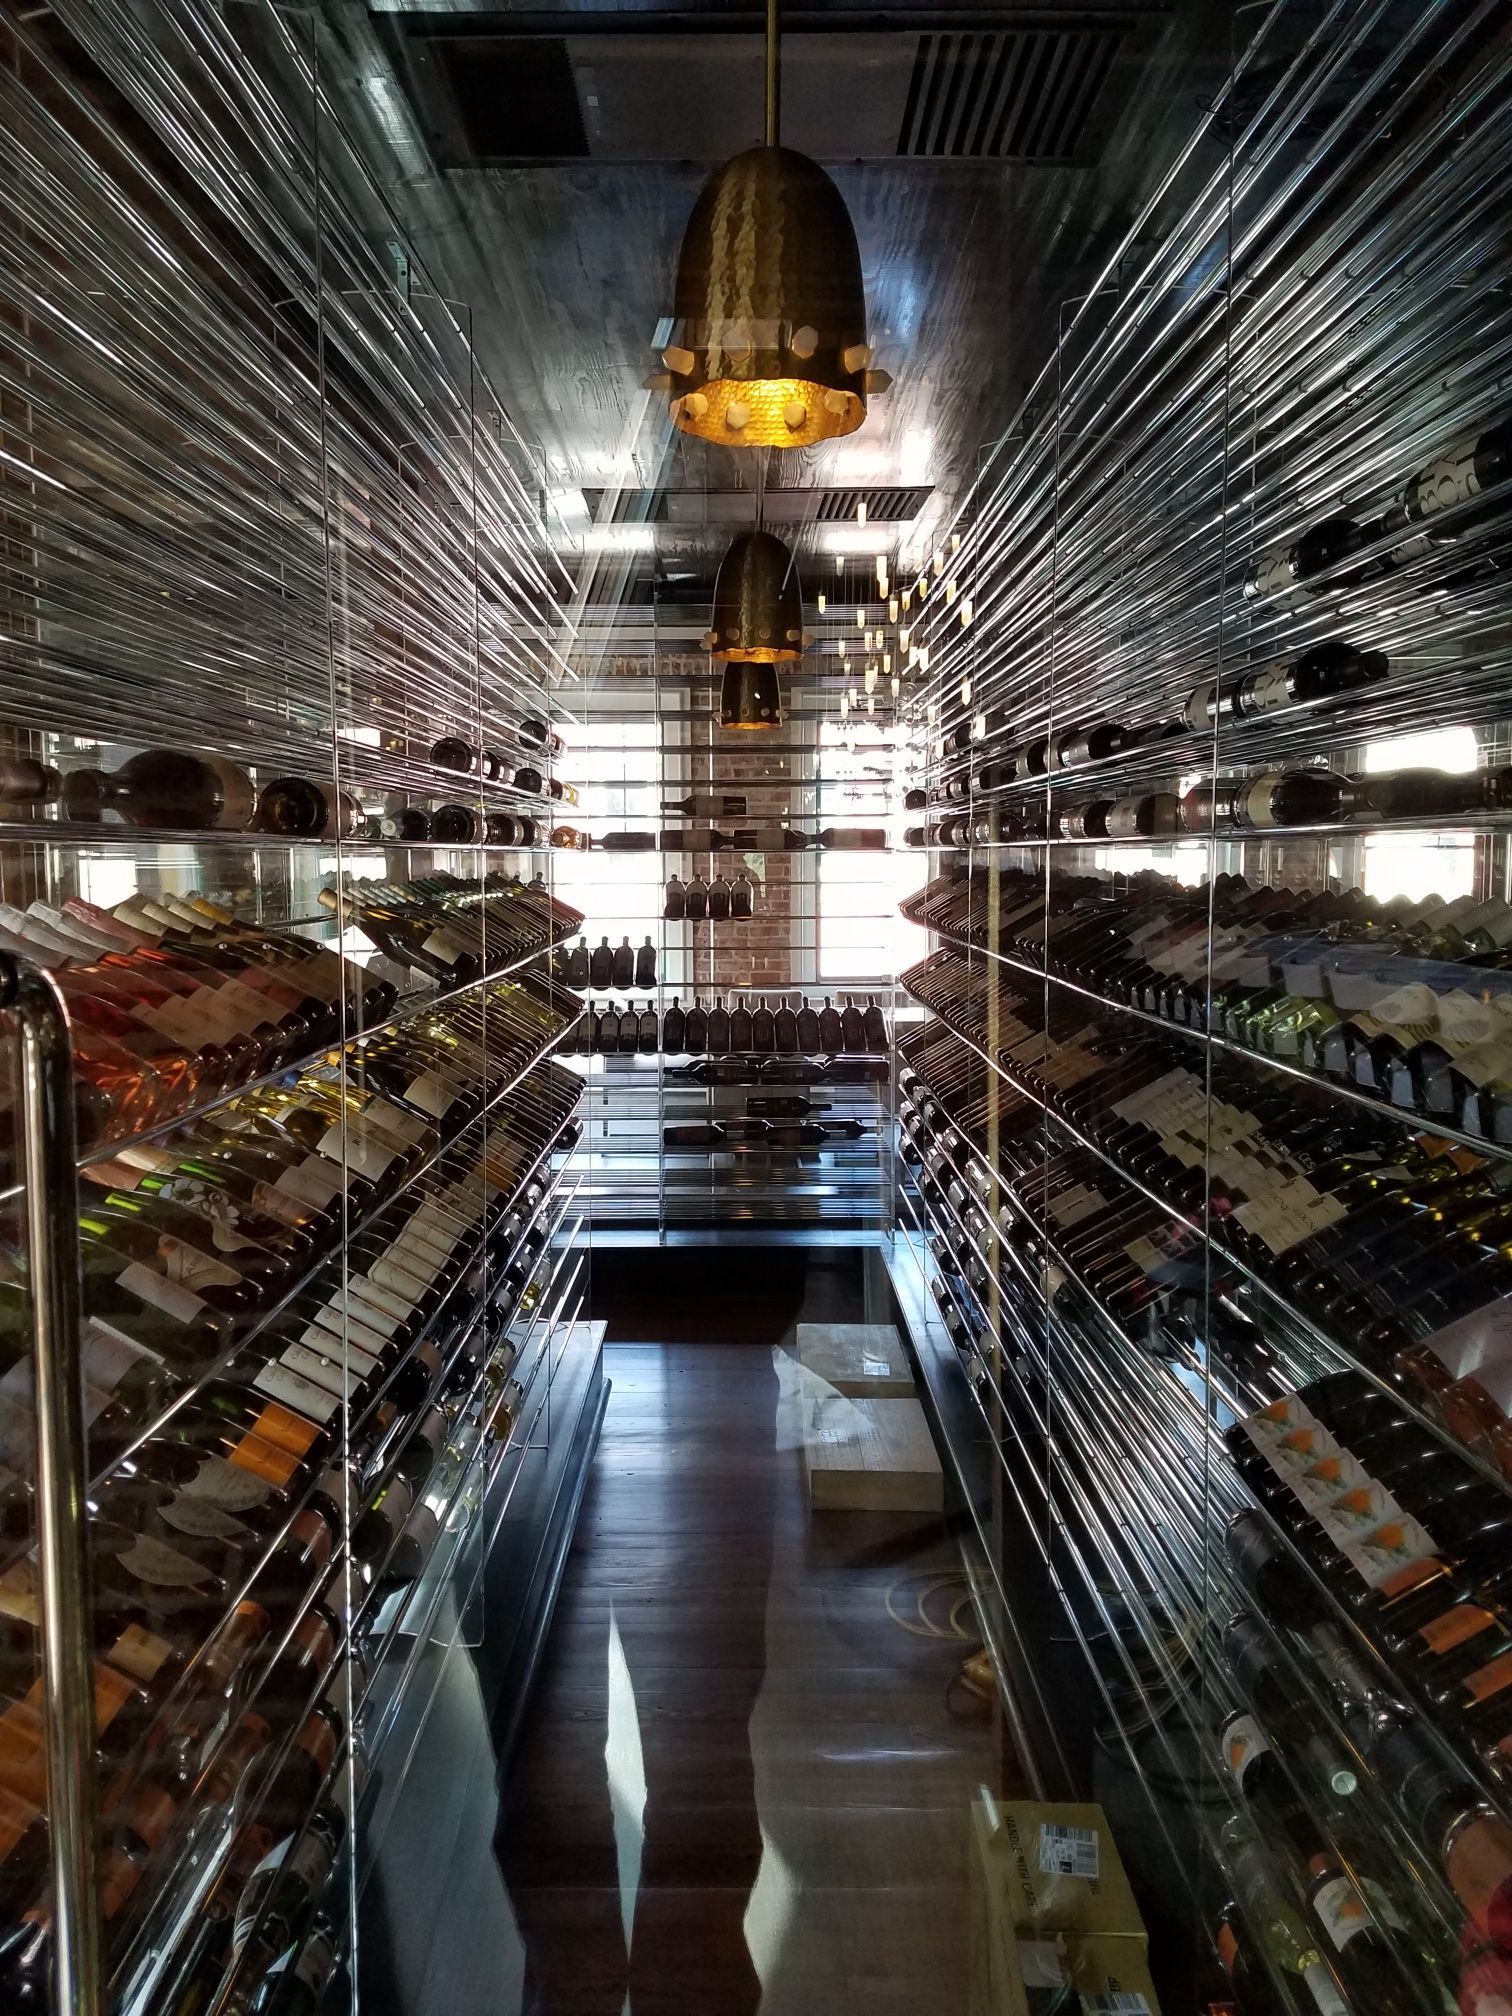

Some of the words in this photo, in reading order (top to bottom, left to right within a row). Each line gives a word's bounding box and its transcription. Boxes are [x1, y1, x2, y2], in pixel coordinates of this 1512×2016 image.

[1004, 1816, 1023, 1853] HANDLE
[1016, 1855, 1030, 1879] WITH
[1107, 1976, 1122, 1992] UP
